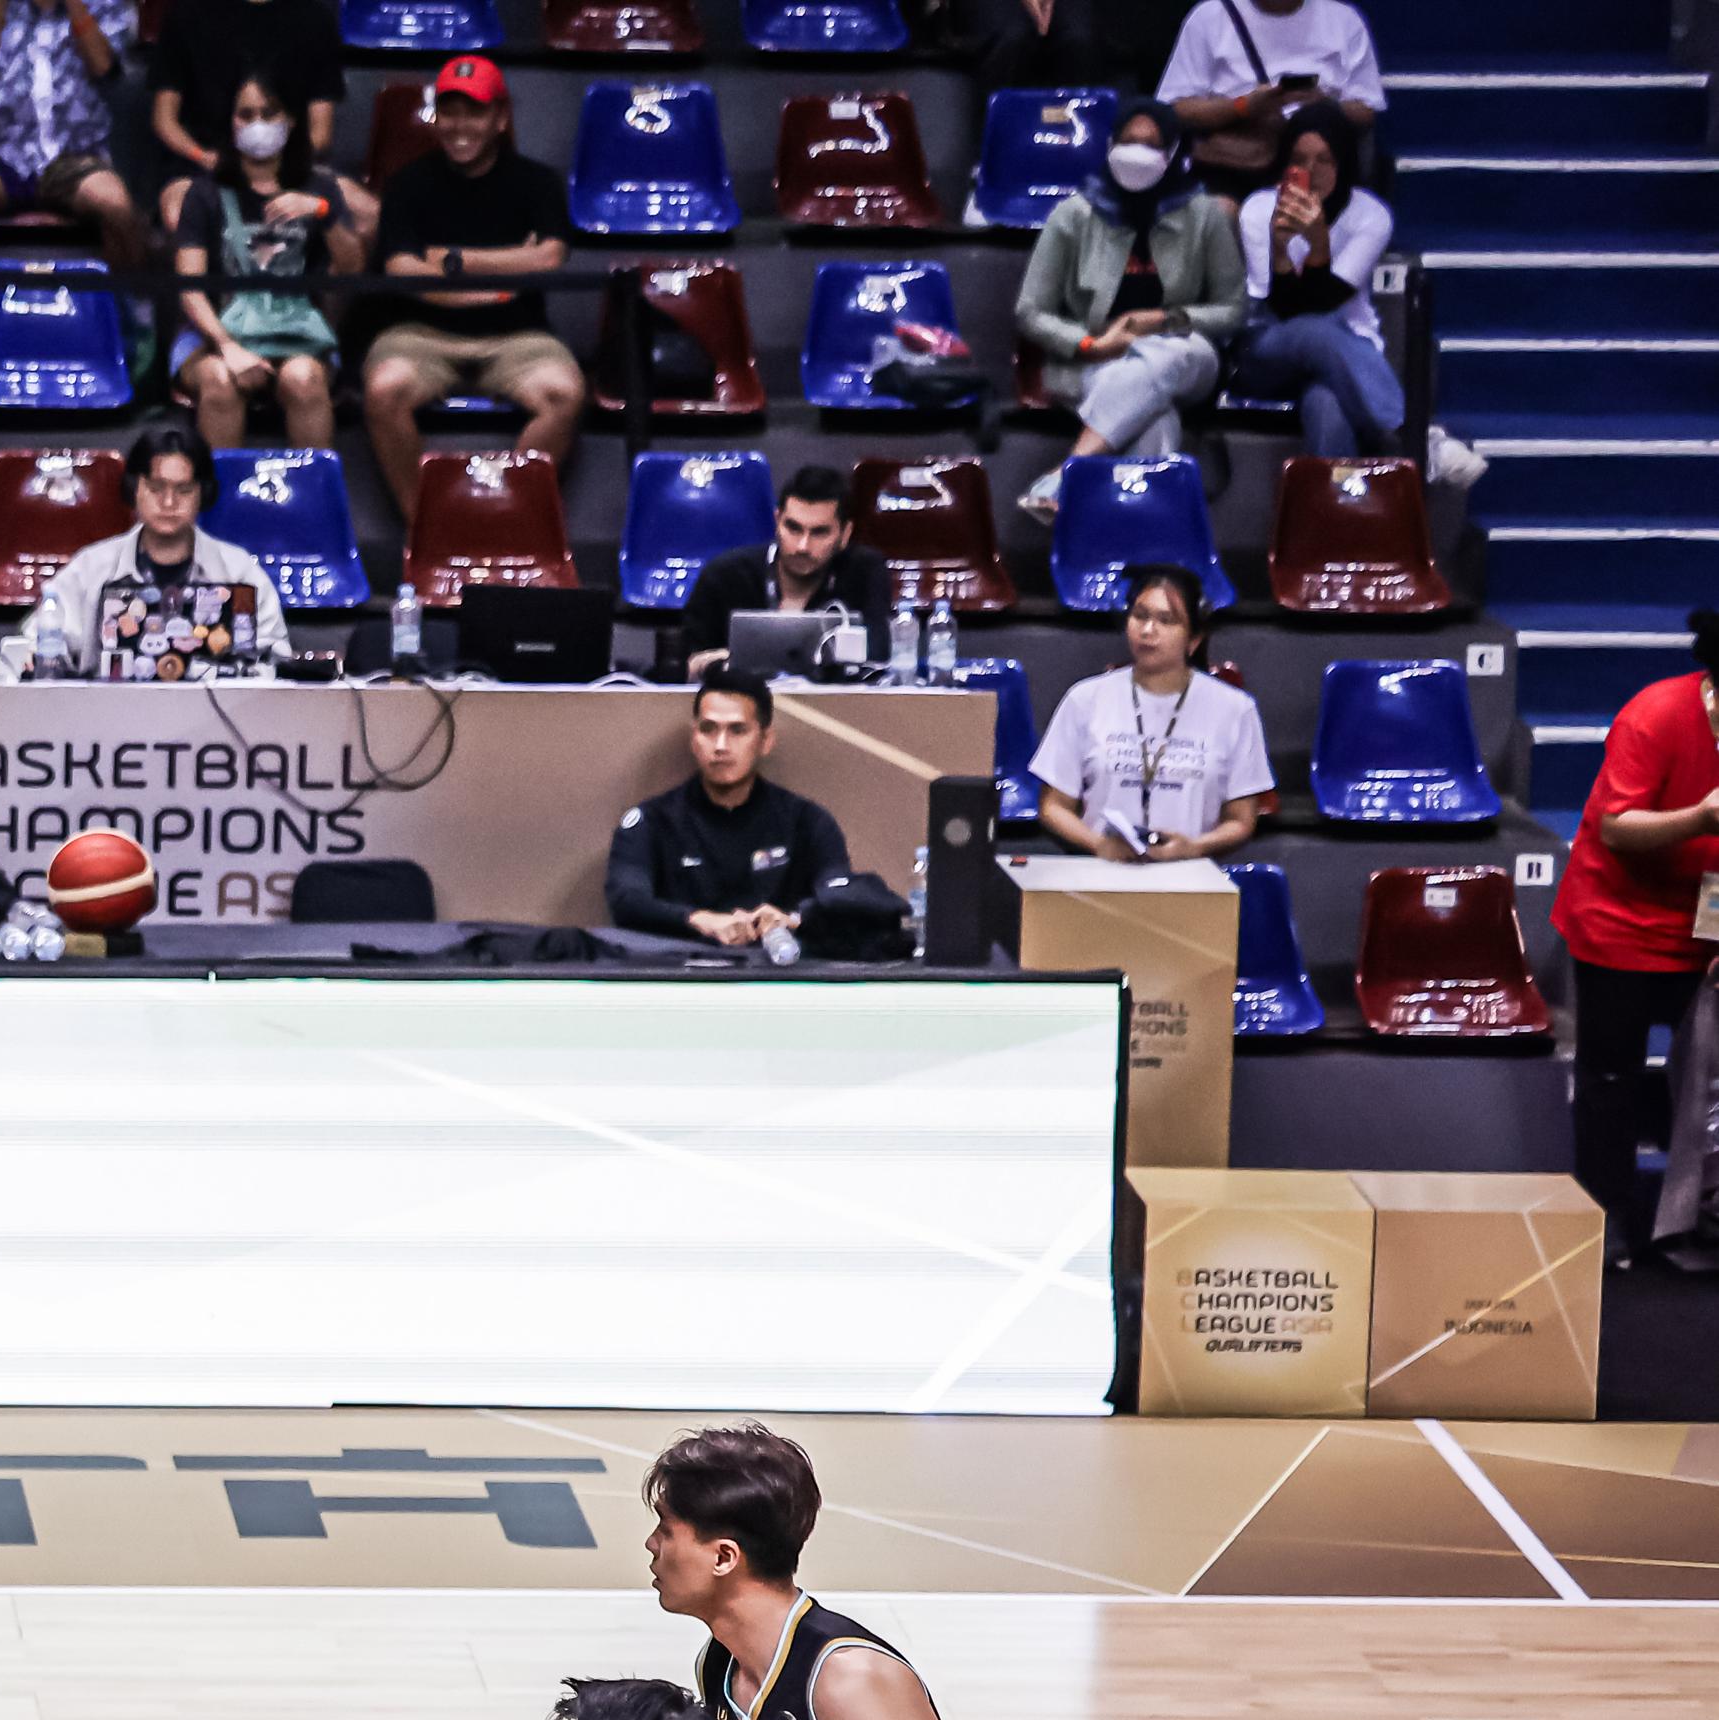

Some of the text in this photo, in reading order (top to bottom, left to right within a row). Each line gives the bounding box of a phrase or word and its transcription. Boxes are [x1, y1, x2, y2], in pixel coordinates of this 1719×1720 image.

[1477, 652, 1493, 670] C
[1176, 1269, 1339, 1289] BASKETBALL
[1180, 1293, 1334, 1312] CHAMPIONS
[1181, 1315, 1333, 1335] LEAGUE ASIA
